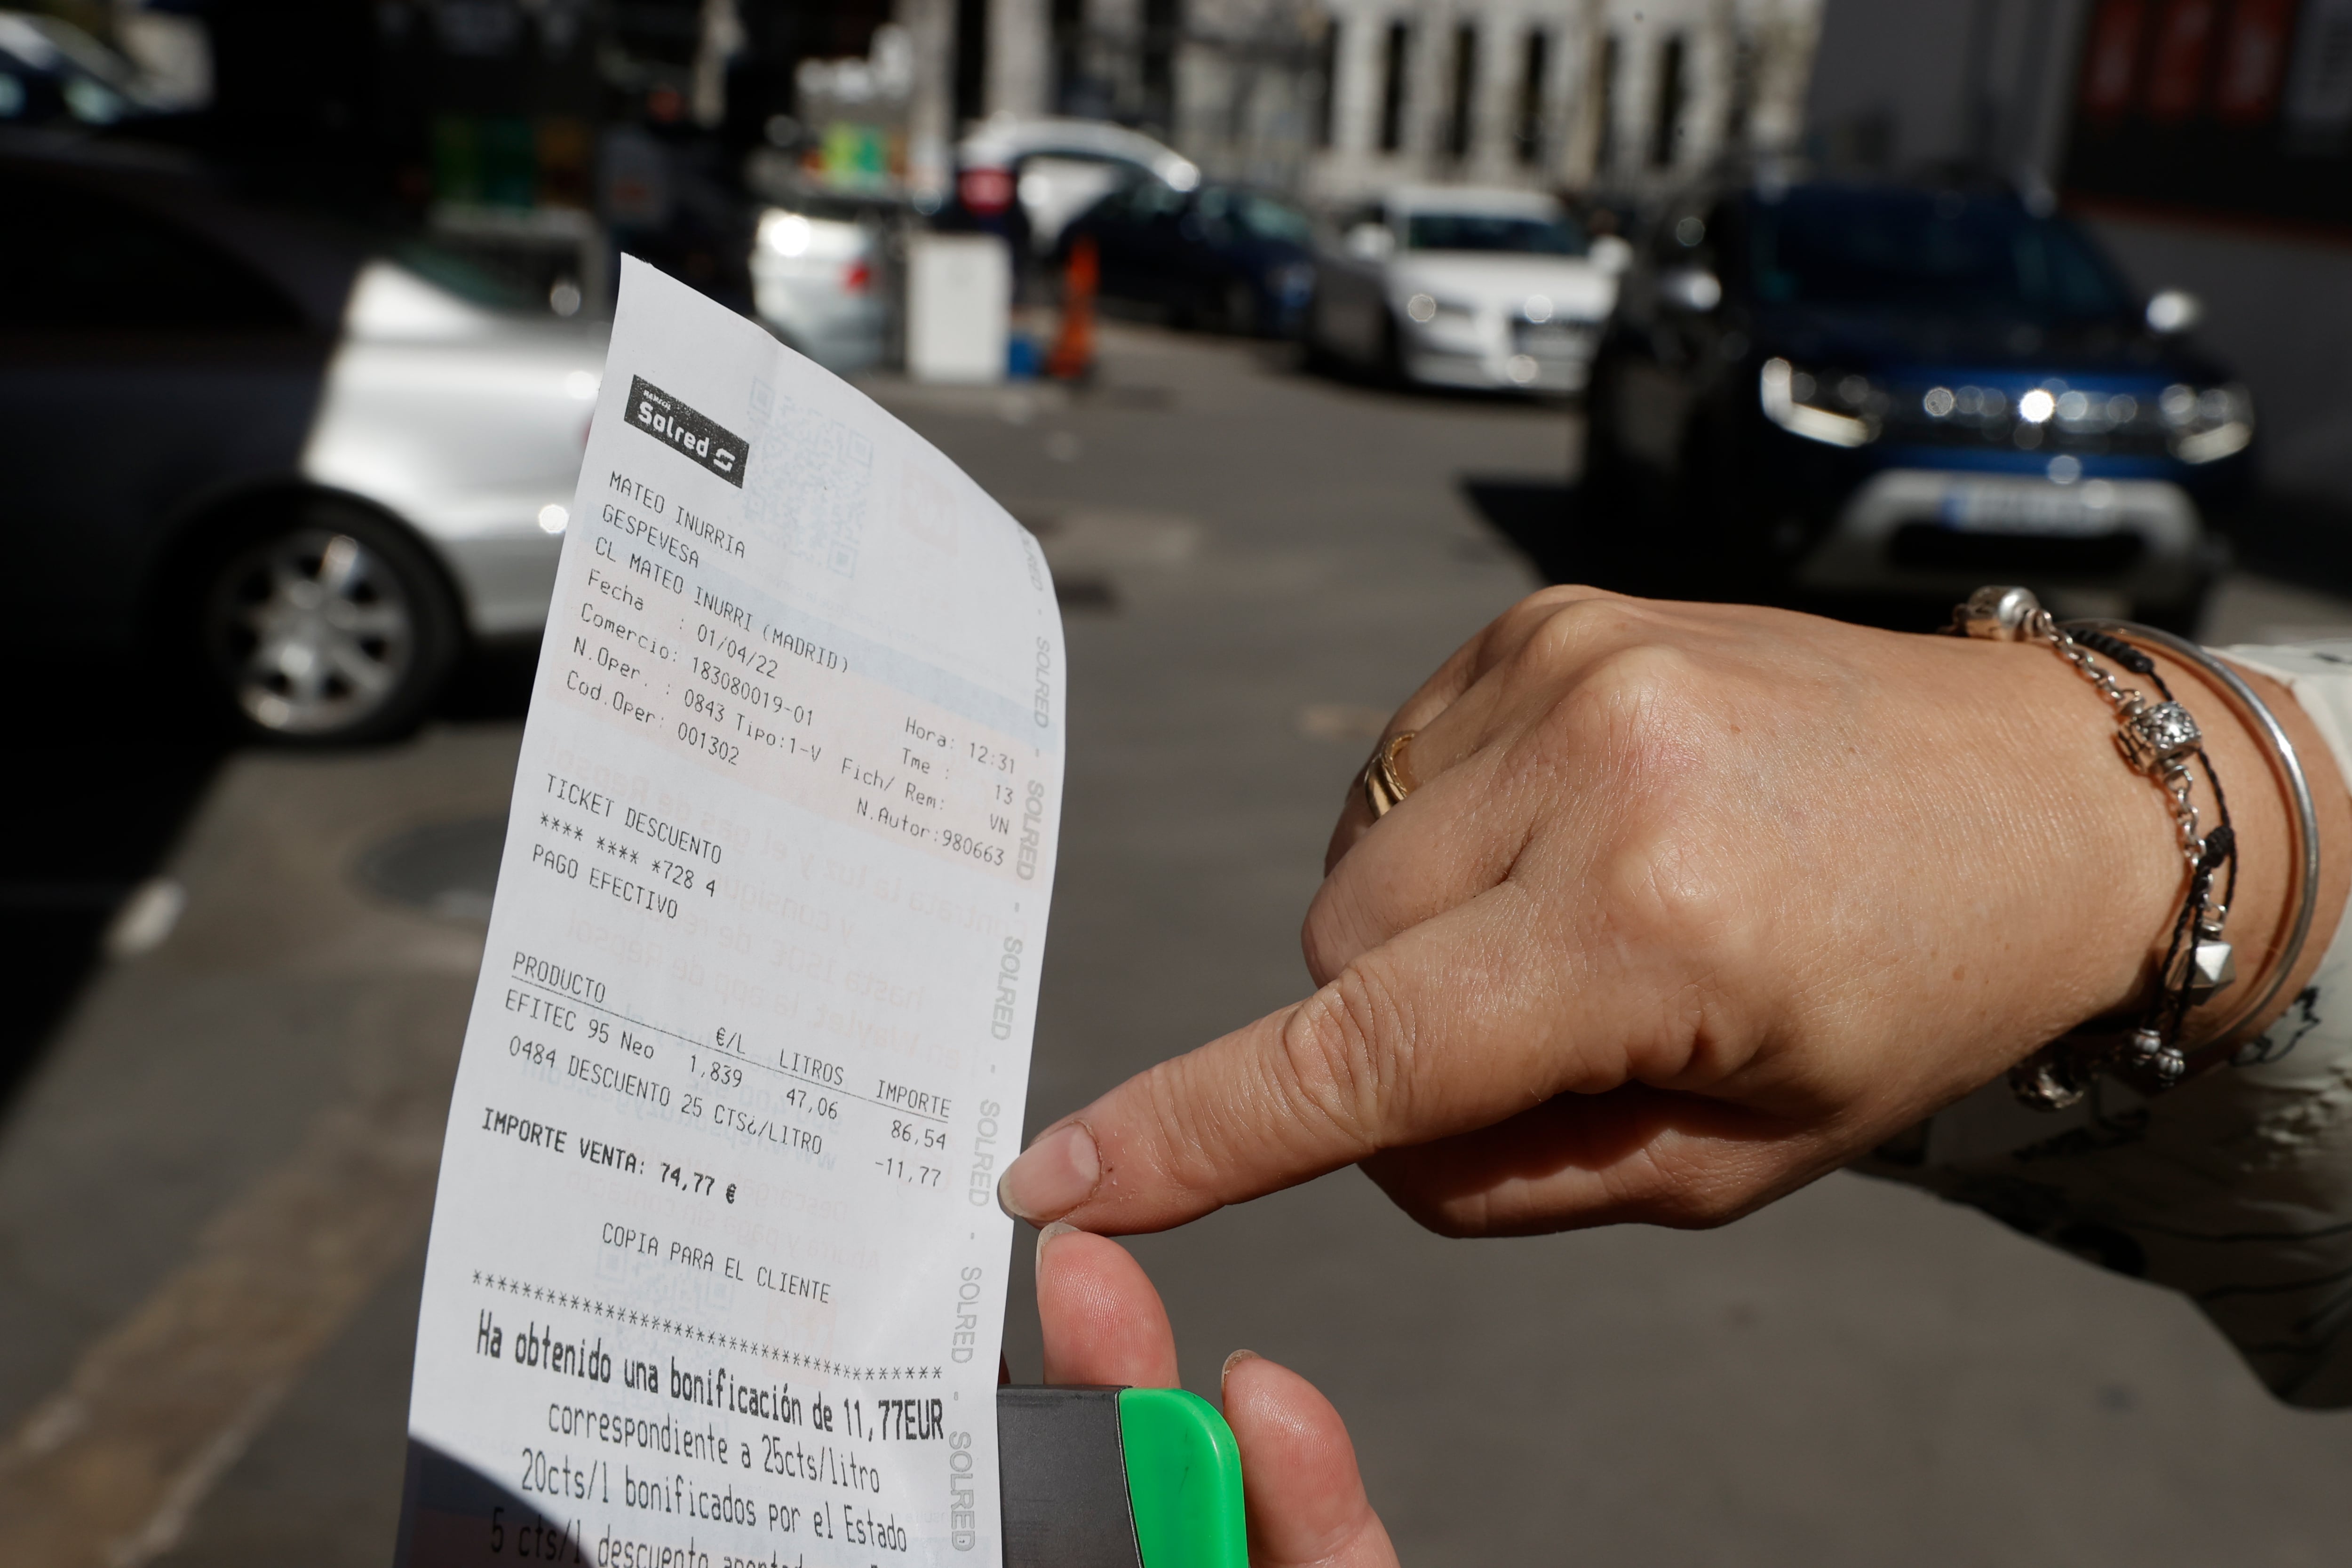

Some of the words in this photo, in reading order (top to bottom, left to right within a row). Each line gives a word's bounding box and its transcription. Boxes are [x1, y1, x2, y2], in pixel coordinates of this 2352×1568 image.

[638, 401, 710, 458] Solred
[603, 504, 699, 568] GESPEVESA
[610, 471, 665, 514] MATEO
[676, 506, 746, 557] INURRIA
[596, 537, 616, 562] CL
[629, 553, 683, 594] MATEO
[694, 587, 754, 632] INURRI
[763, 624, 848, 673] (MADRID)
[582, 603, 677, 661] Comercio:
[692, 657, 813, 726] 183080019-01
[903, 748, 931, 774] Tme
[995, 784, 1013, 805] 13
[588, 569, 644, 612] Fecha
[698, 624, 778, 679] 01/04/22
[905, 716, 954, 750] Hora:
[969, 742, 1015, 774] 12:31
[1034, 636, 1051, 728] SOLRED
[567, 671, 665, 728] Cod.Oper:
[678, 722, 740, 766] 001302
[857, 797, 1005, 866] N.Autor:980663
[684, 689, 725, 722] 0843
[737, 713, 821, 762] Tipo:1-V
[842, 757, 895, 791] Fich/
[905, 782, 944, 811] Rem:
[990, 814, 1010, 835] VN
[547, 773, 614, 817] TICKET
[625, 808, 722, 865] DESCUENTO
[1016, 779, 1044, 881] SOLRED
[532, 844, 579, 880] PAGO
[589, 868, 678, 919] EFECTIVO
[706, 880, 715, 897] 4
[513, 951, 606, 1003] PRODUCTO
[716, 1027, 745, 1054] €/L
[780, 1049, 844, 1086] LITROS
[876, 1079, 952, 1119] IMPORTE
[991, 936, 1023, 1041] SOLRED
[505, 989, 577, 1032] EFITEC
[588, 1019, 610, 1043] 95
[620, 1031, 654, 1059] Neo
[691, 1054, 743, 1088] 1,839
[786, 1088, 838, 1120] 47,06
[891, 1120, 946, 1150] 86,54
[509, 1035, 556, 1069] 0484
[568, 1054, 670, 1106] DESCUENTO
[681, 1093, 702, 1118] 25
[875, 1158, 941, 1187] -11,77
[482, 1107, 567, 1154] IMPORTE
[580, 1137, 644, 1175] VENTA:
[660, 1162, 715, 1196] 74,77
[726, 1183, 736, 1204] €
[968, 1098, 1001, 1207] SOLRED
[603, 1222, 659, 1256] COPIA
[670, 1241, 714, 1272] PARA
[725, 1257, 744, 1281] EL
[756, 1266, 831, 1304] CLIENTE
[951, 1266, 982, 1364] SOLRED
[477, 1308, 502, 1359] Ha
[515, 1321, 611, 1384] obtenido
[624, 1359, 659, 1394] una
[670, 1356, 802, 1427] bonificación
[812, 1390, 833, 1432] de
[844, 1398, 944, 1442] 11,77EUR
[522, 1447, 609, 1504] 20cts/l
[626, 1465, 756, 1527] bonificados
[769, 1503, 801, 1534] por
[814, 1501, 833, 1539] el
[844, 1504, 907, 1552] Estado
[548, 1403, 728, 1465] correspondiente
[741, 1442, 751, 1469] a
[762, 1433, 880, 1494] 25cts/litro
[949, 1431, 976, 1552] SOLRED
[491, 1507, 504, 1554] 5
[519, 1514, 581, 1564] cts/l
